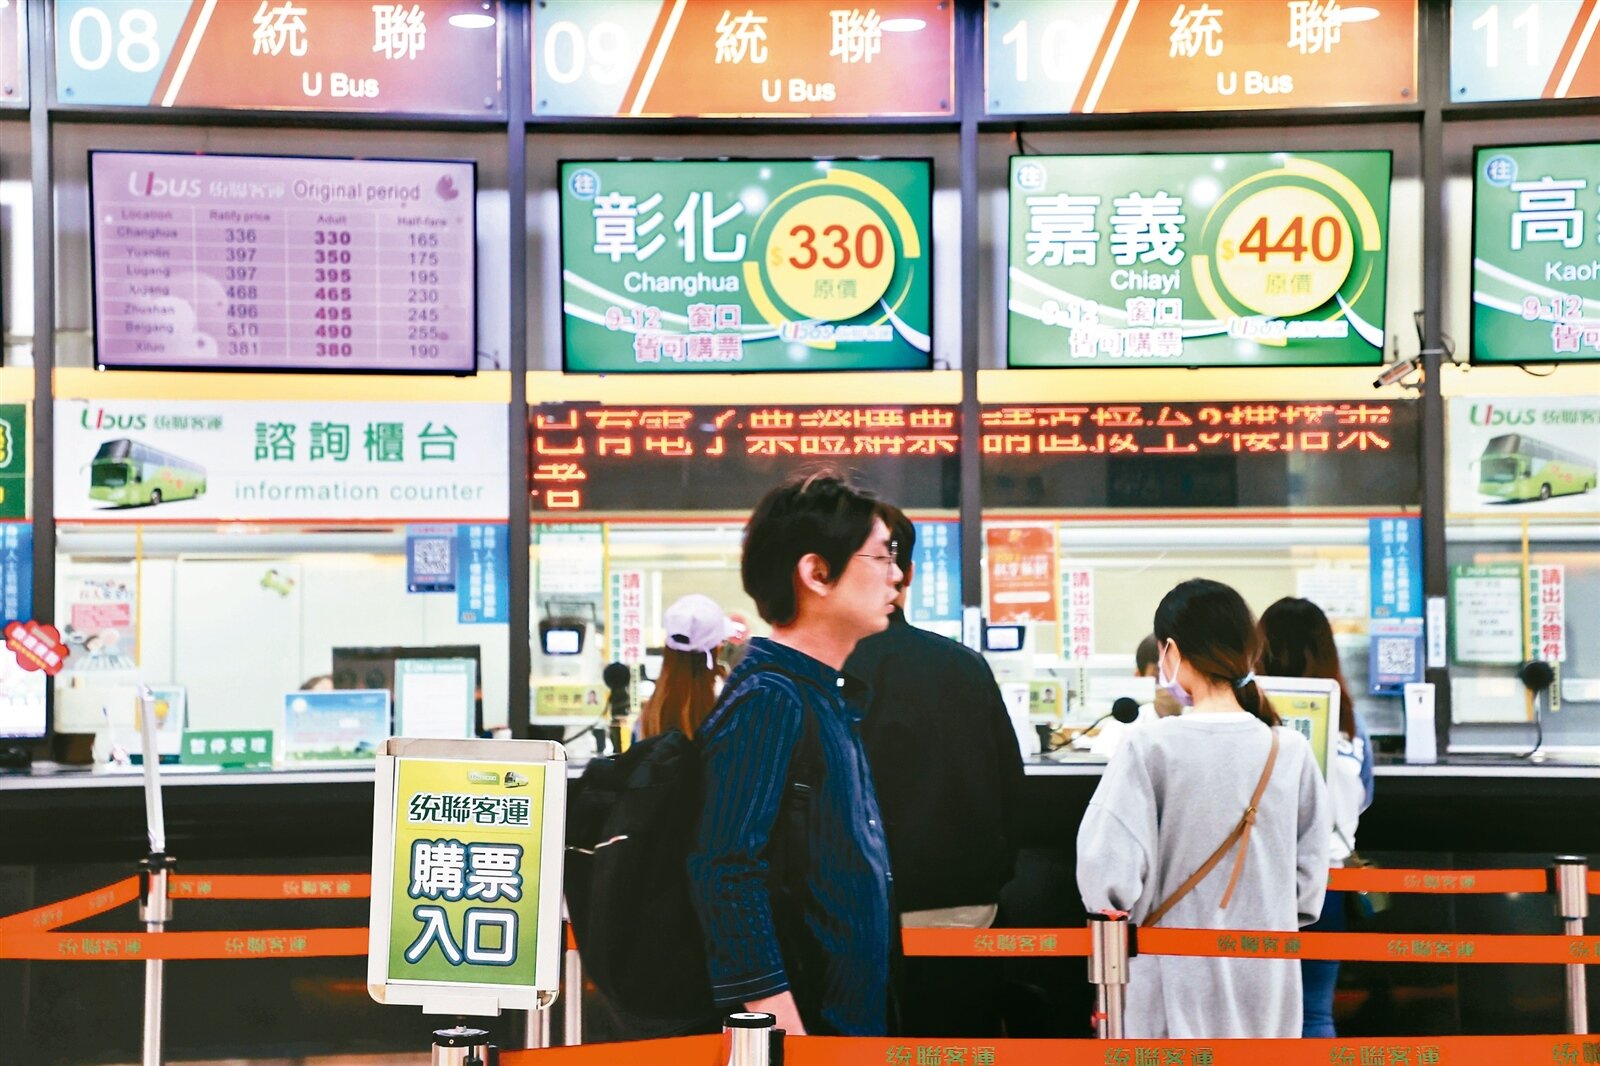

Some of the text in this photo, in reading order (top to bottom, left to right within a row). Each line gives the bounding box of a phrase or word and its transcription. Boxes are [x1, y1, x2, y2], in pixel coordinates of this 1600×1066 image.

[68, 8, 161, 71] 08
[714, 8, 882, 65] 統聯
[1471, 8, 1545, 69] 11
[543, 20, 629, 84] 09
[1001, 19, 1078, 84] 10
[303, 73, 379, 97] U Bus
[762, 79, 836, 102] U Bus
[1217, 70, 1293, 95] U Bus
[293, 180, 421, 203] Original period
[121, 210, 172, 221] Location
[317, 213, 348, 225] Adult
[1510, 176, 1600, 250] 高
[225, 228, 257, 243] 336
[314, 231, 351, 245] 330
[410, 233, 438, 247] 165
[592, 191, 747, 264] 彰化
[1025, 191, 1186, 268] 嘉義
[226, 248, 257, 261] 397
[314, 249, 351, 264] 350
[410, 252, 438, 266] 175
[226, 267, 257, 281] 397
[314, 268, 351, 282] 395
[410, 270, 438, 285] 195
[624, 272, 740, 297] Changhua
[1110, 270, 1181, 293] Chiayi
[226, 285, 258, 300] 468
[314, 287, 352, 301] 465
[408, 289, 438, 303] 230
[227, 304, 258, 319] 496
[314, 307, 352, 321] 495
[408, 308, 439, 322] 245
[227, 323, 259, 338] 510
[315, 325, 352, 339] 490
[408, 326, 439, 340] 255
[228, 341, 258, 356] 381
[315, 343, 352, 357] 380
[410, 345, 439, 359] 190
[254, 421, 459, 463] 諮詢櫃台
[235, 482, 485, 502] information counter
[409, 795, 530, 826] 統聯客運
[408, 839, 523, 903] 購票
[404, 905, 519, 967] 入口
